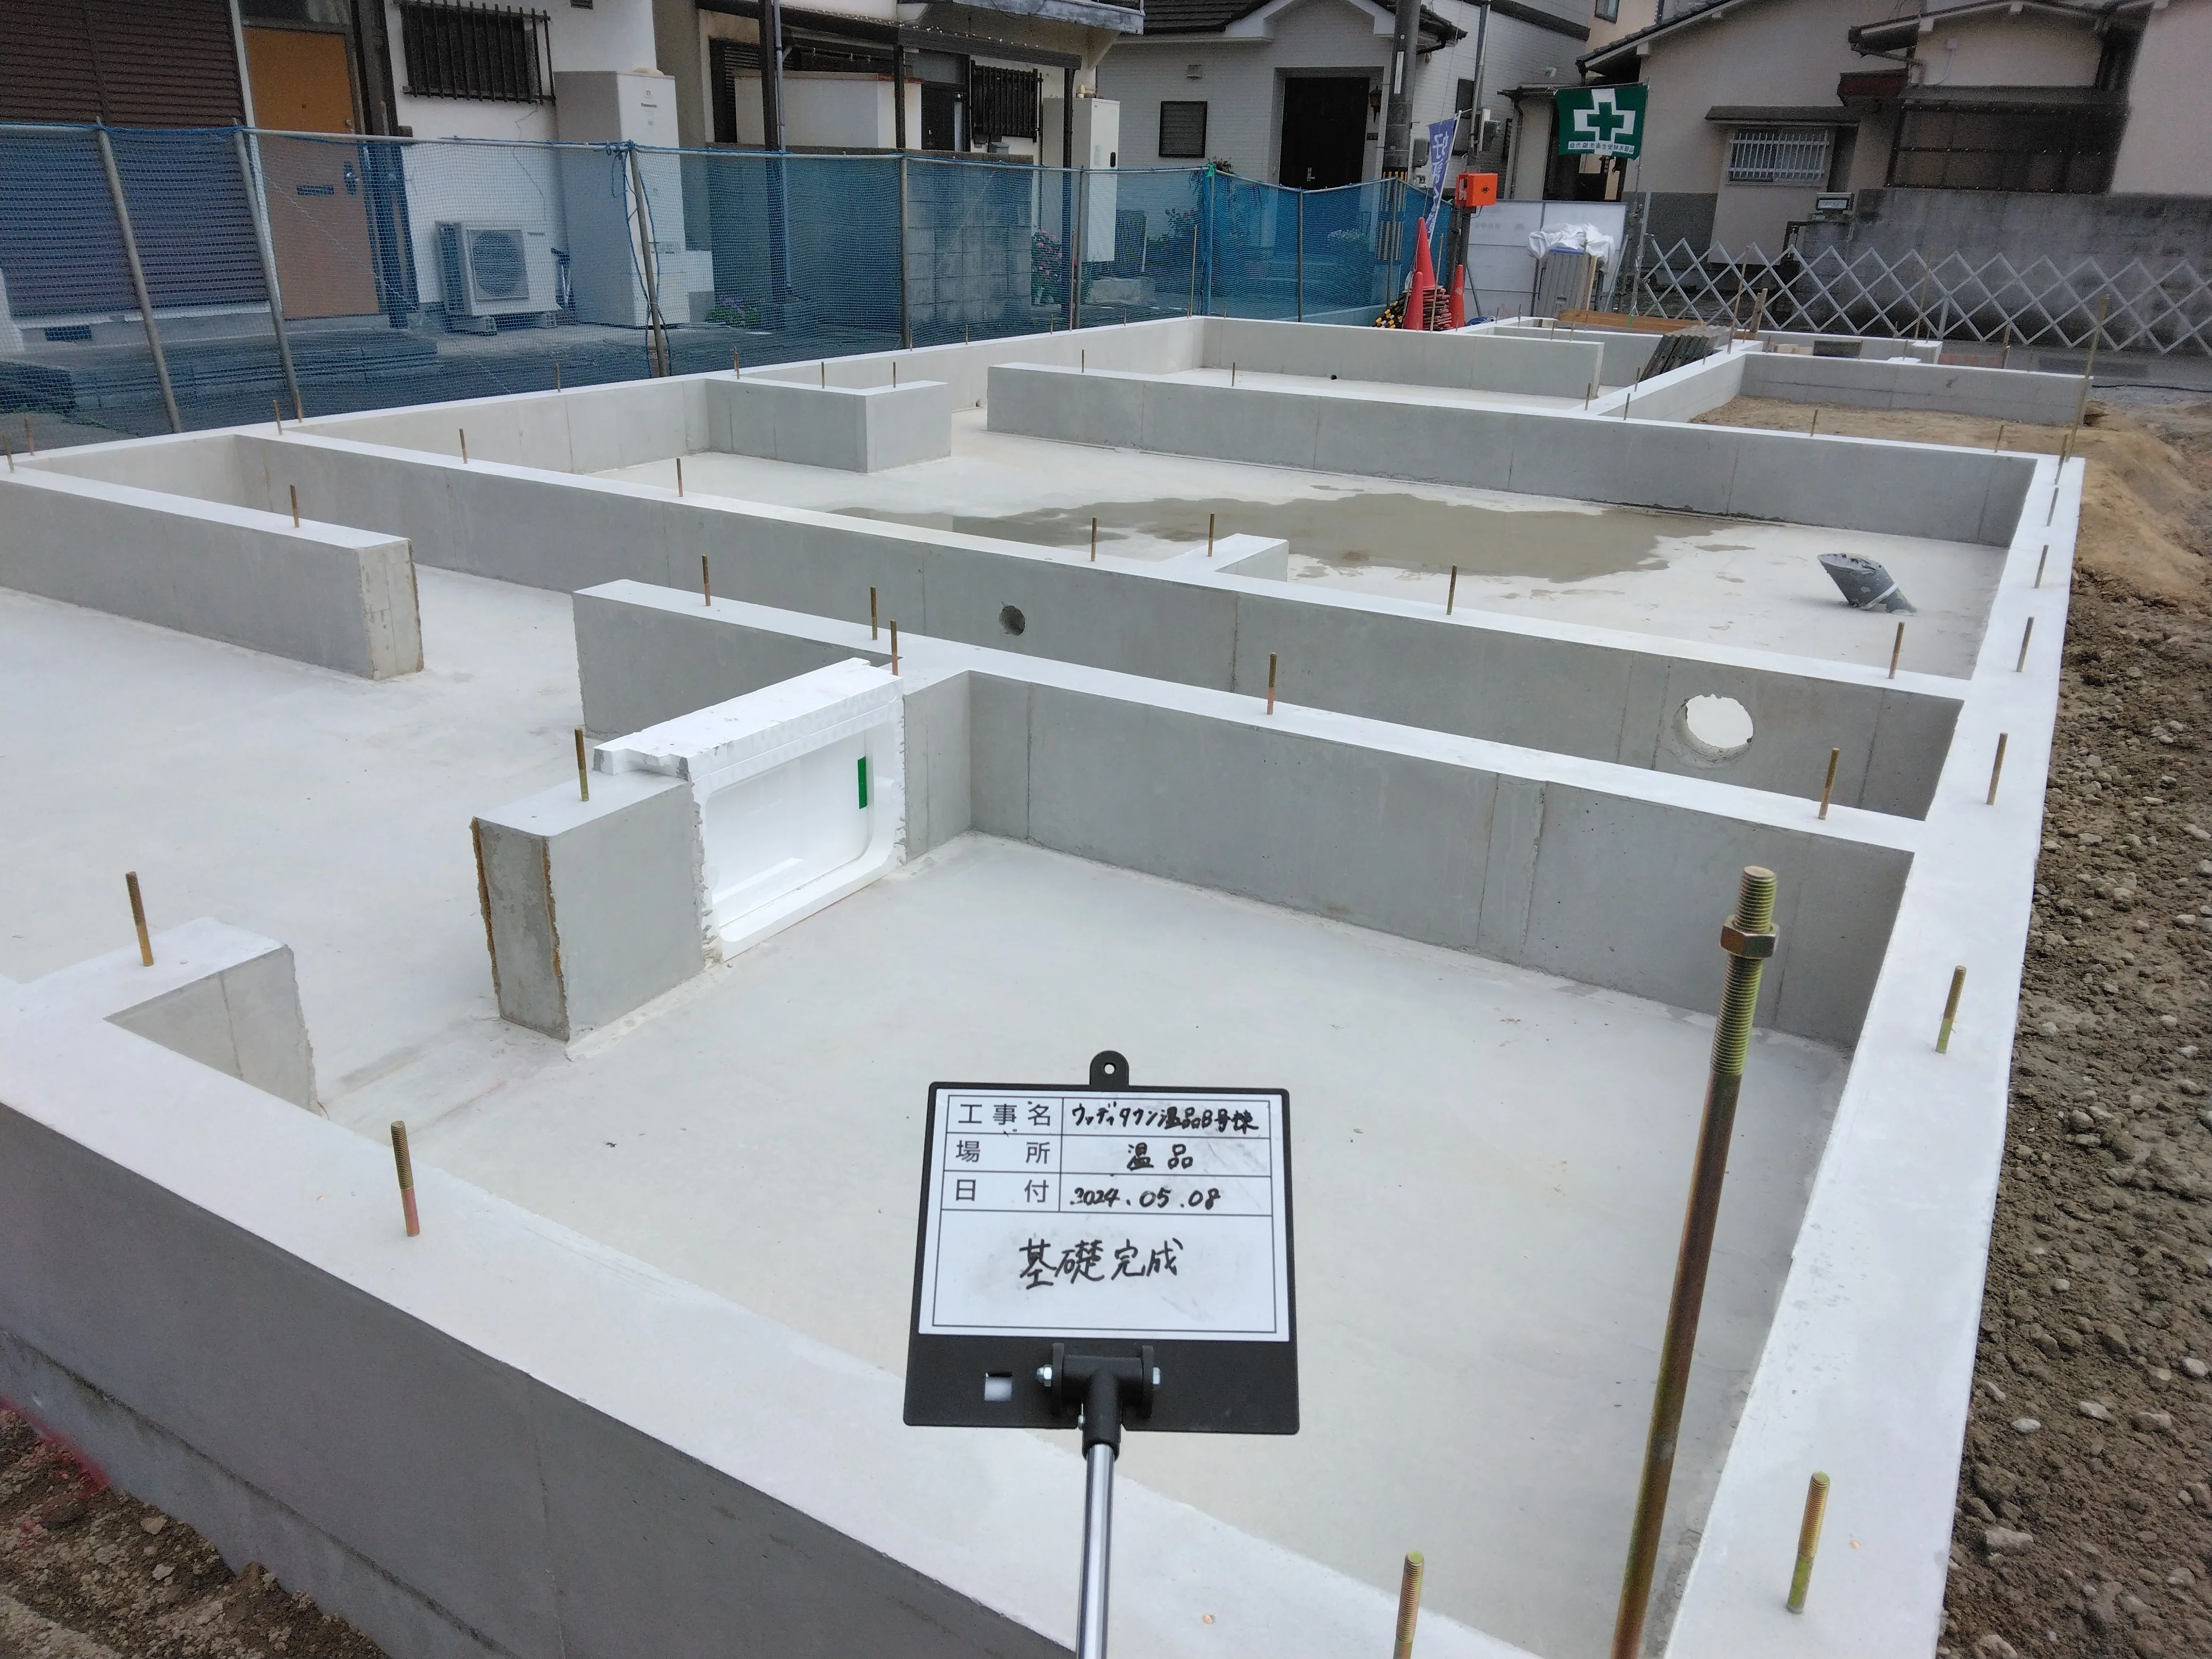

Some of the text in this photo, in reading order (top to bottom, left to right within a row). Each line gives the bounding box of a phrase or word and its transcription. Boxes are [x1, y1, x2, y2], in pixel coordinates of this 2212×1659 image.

[958, 1103, 1051, 1126] 工事名
[955, 1139, 1051, 1164] 場所
[955, 1178, 1049, 1203] 日付
[1019, 1237, 1184, 1290] 基礎完成
